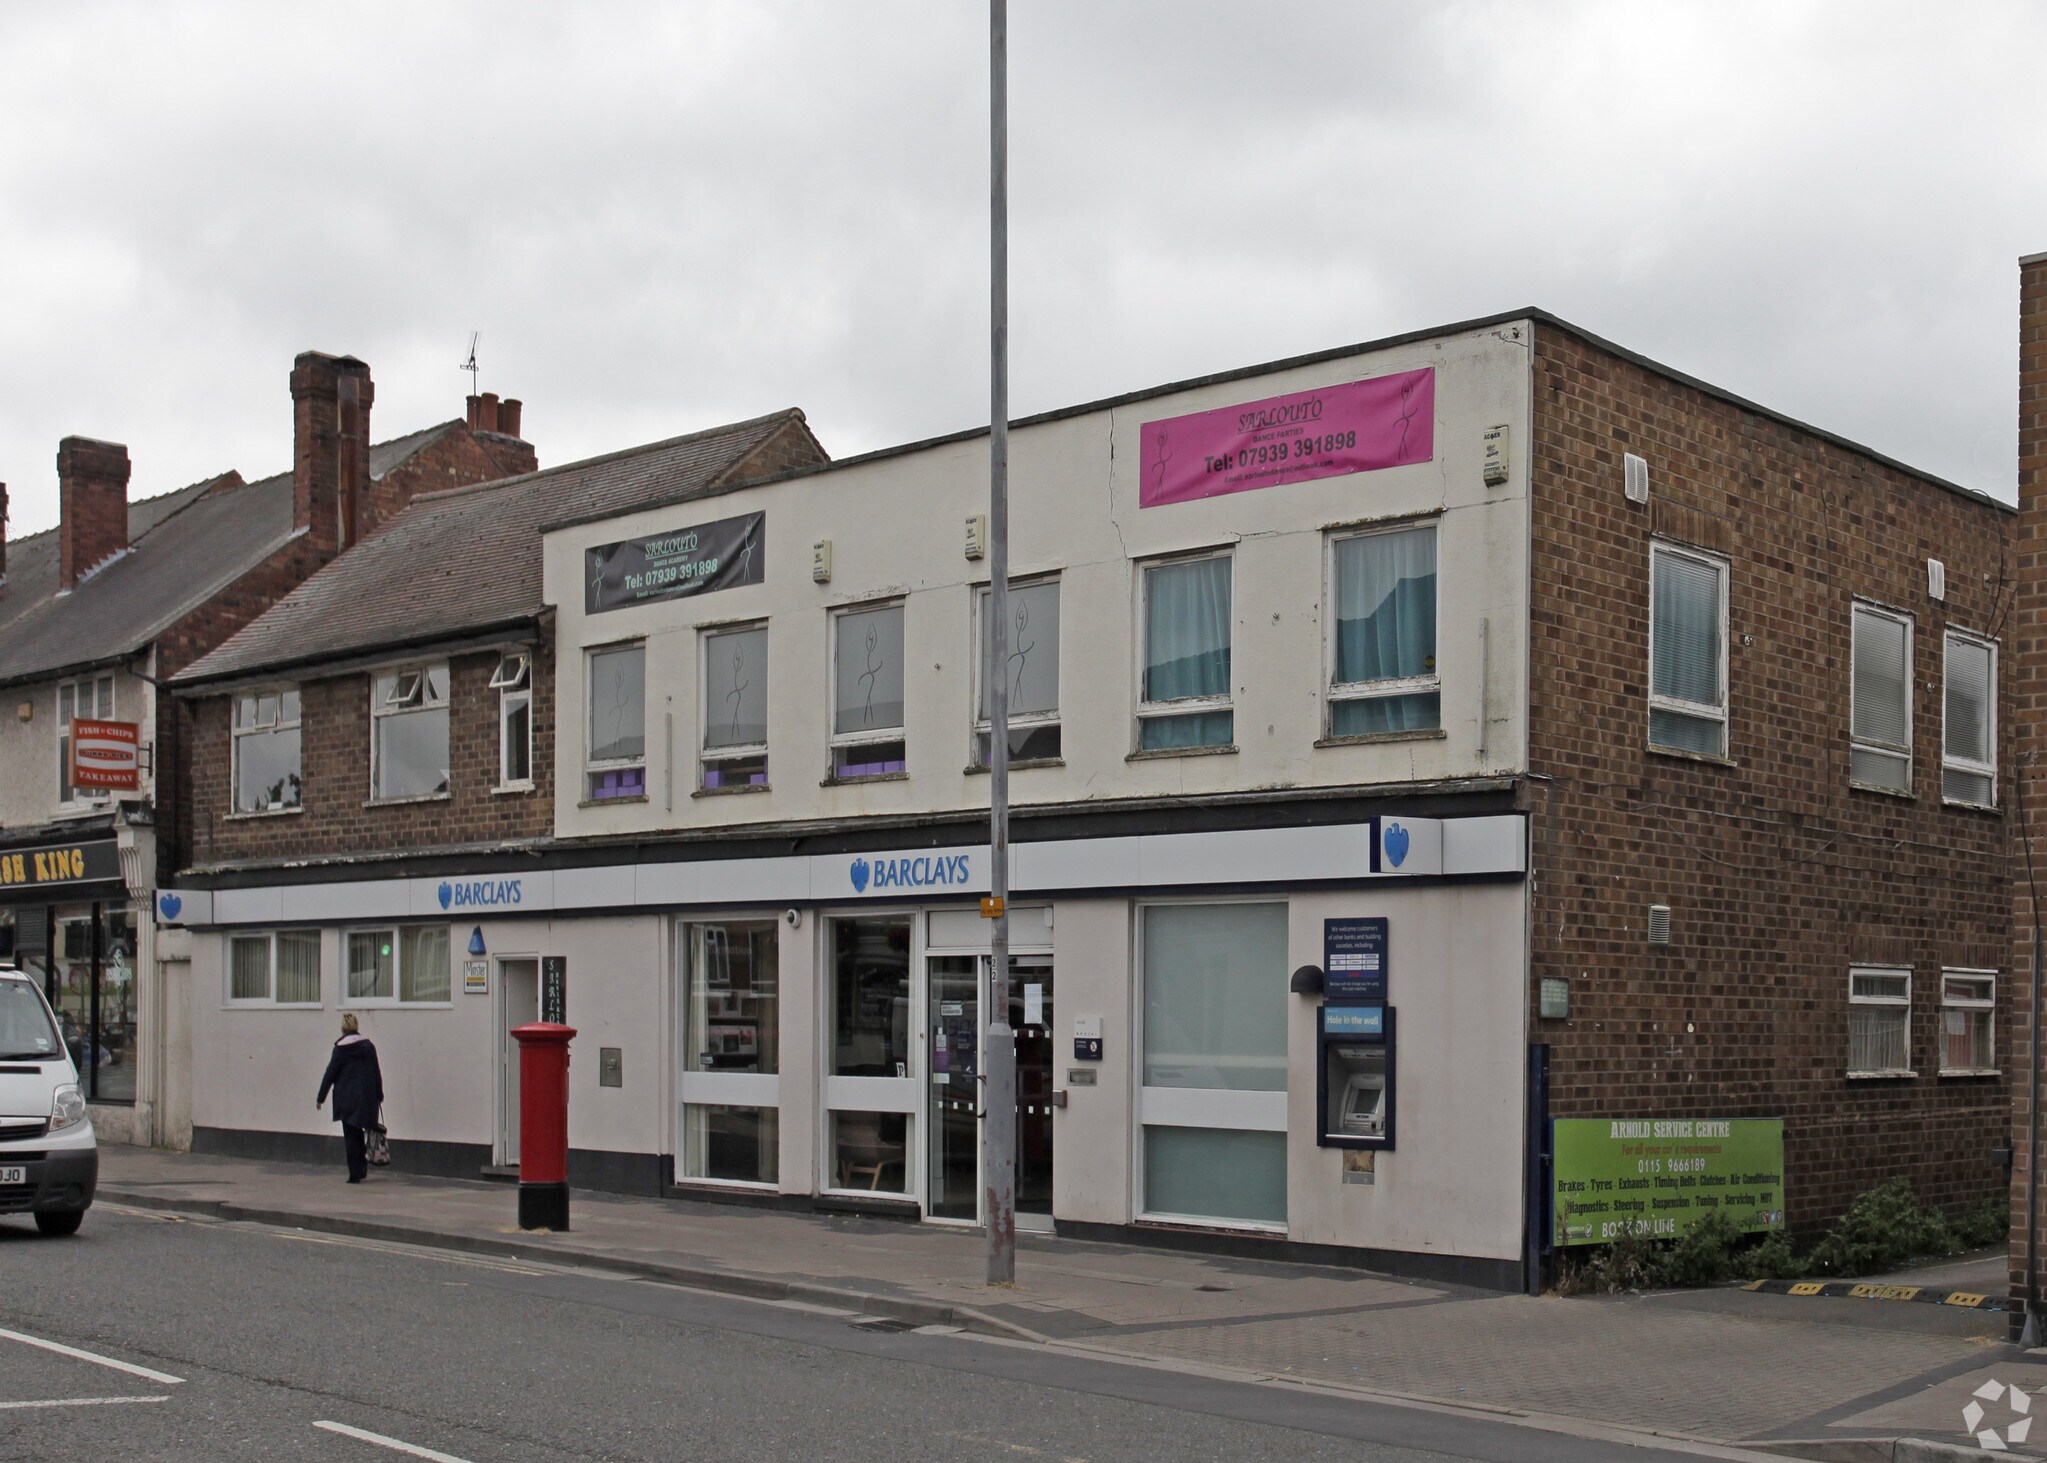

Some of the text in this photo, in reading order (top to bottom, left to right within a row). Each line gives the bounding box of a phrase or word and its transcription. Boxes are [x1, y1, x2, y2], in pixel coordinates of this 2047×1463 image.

[1238, 396, 1323, 432] SARLOUTO
[1253, 427, 1304, 443] DANCE PARTIES
[1204, 430, 1356, 473] Tel: 07939 391898
[645, 531, 698, 558] SARLOUTO
[653, 555, 688, 567] DANCE ACADEMY
[625, 558, 718, 590] Tel: 07939 391898
[79, 727, 99, 735] FISH
[106, 728, 134, 739] CHIPS
[79, 770, 133, 782] TAKEAWAY
[0, 848, 84, 884] SH KING
[873, 855, 969, 888] BARCLAYS
[455, 880, 521, 905] BARCLAYS
[1327, 1015, 1378, 1024] Hole in the wall
[1611, 1122, 1730, 1138] ARNOLD SERVICE CENTRE
[1645, 1146, 1661, 1157] your
[1639, 1158, 1705, 1173] 0115 9666189
[1558, 1172, 1780, 1193] Brakes Tyres Exhausts Timing Belts Clutches Air Conditioning
[1567, 1192, 1773, 1216] Diagnostics Steering Suspension Tuning Servicing MOT
[1654, 1218, 1675, 1234] LINE
